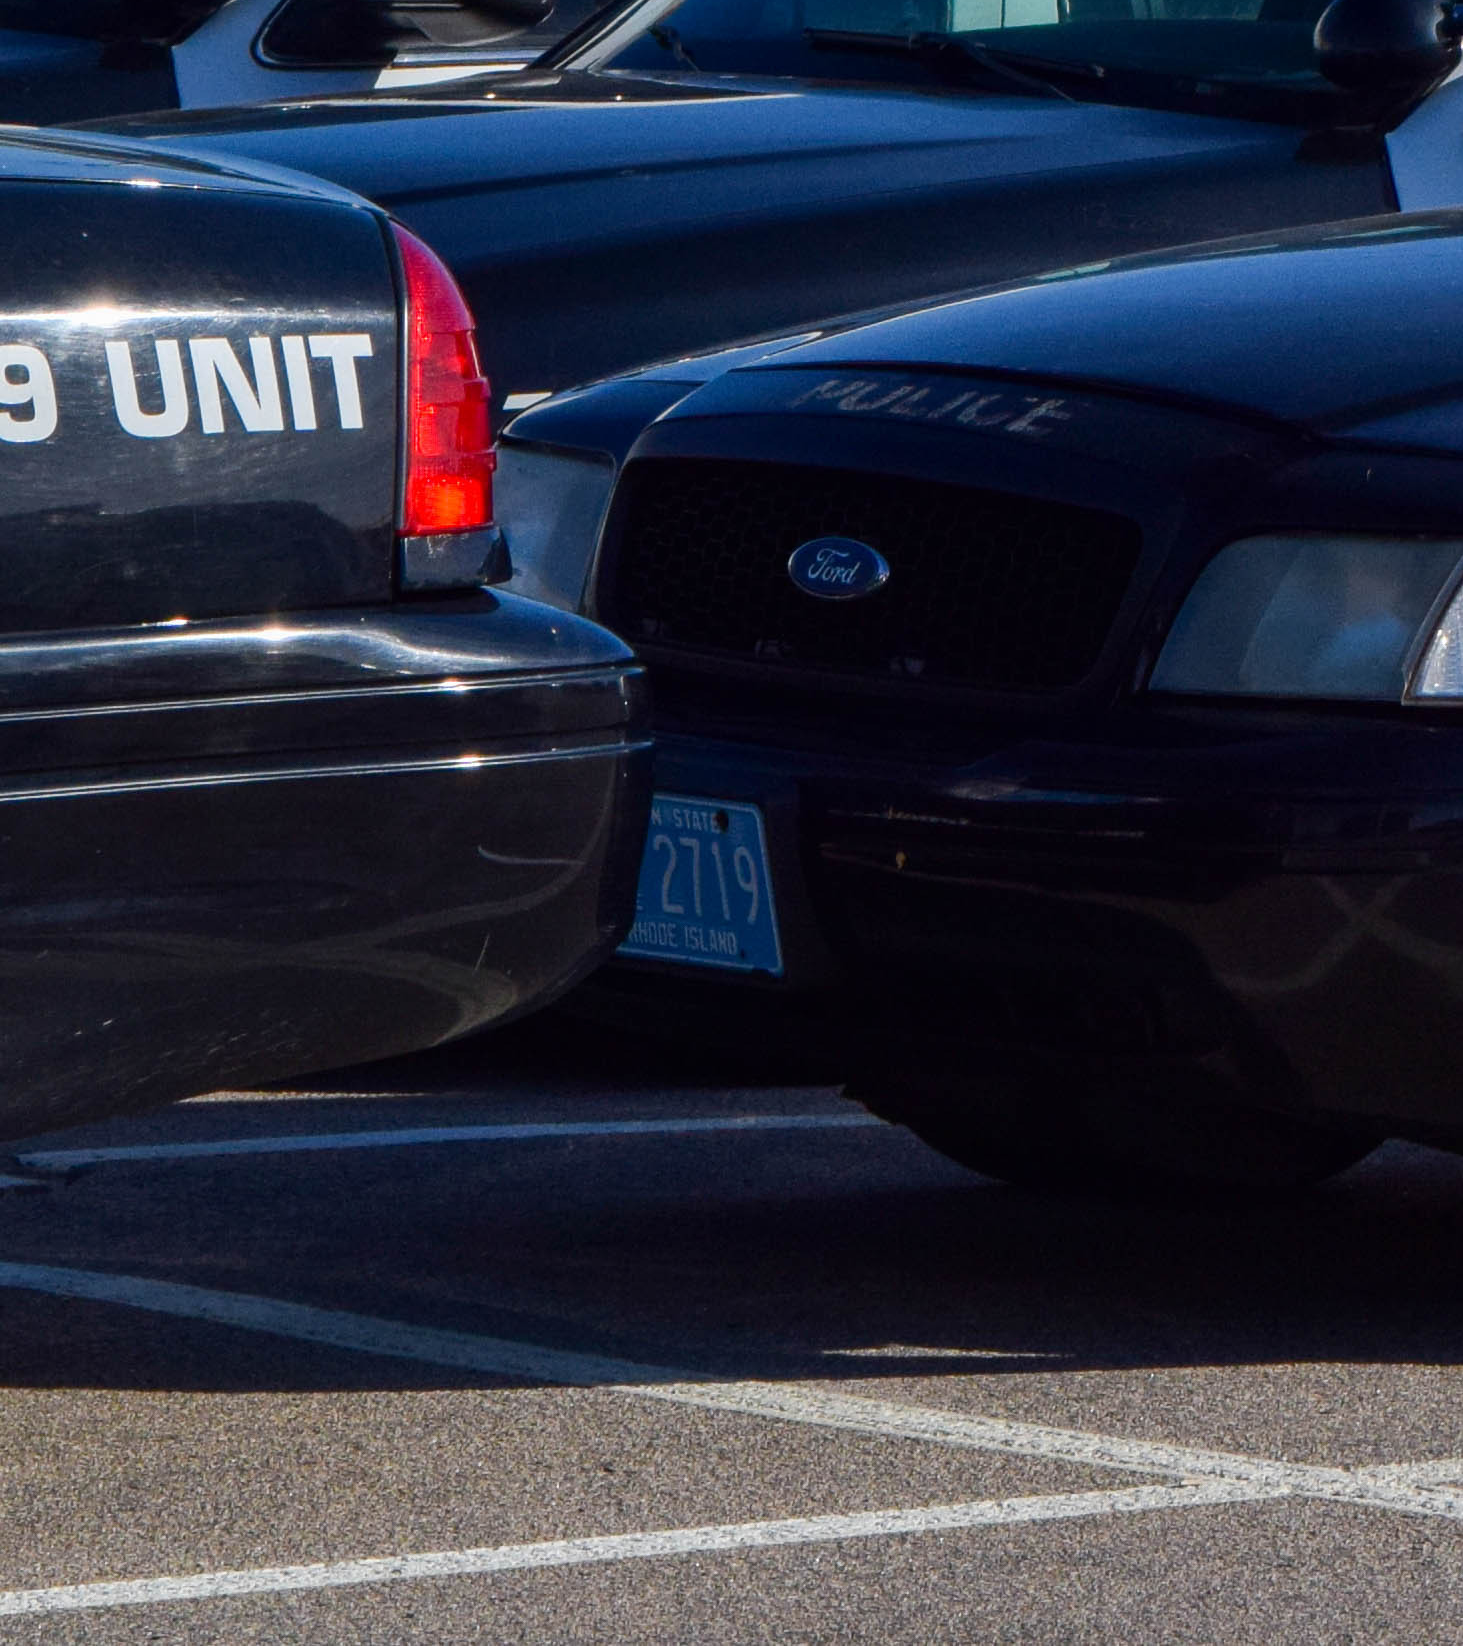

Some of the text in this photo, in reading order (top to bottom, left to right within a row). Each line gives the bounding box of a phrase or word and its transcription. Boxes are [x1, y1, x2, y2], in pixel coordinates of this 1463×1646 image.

[104, 333, 374, 439] UNIT
[807, 548, 862, 585] Ford
[652, 834, 759, 926] 2719
[684, 925, 738, 956] ISLAND
